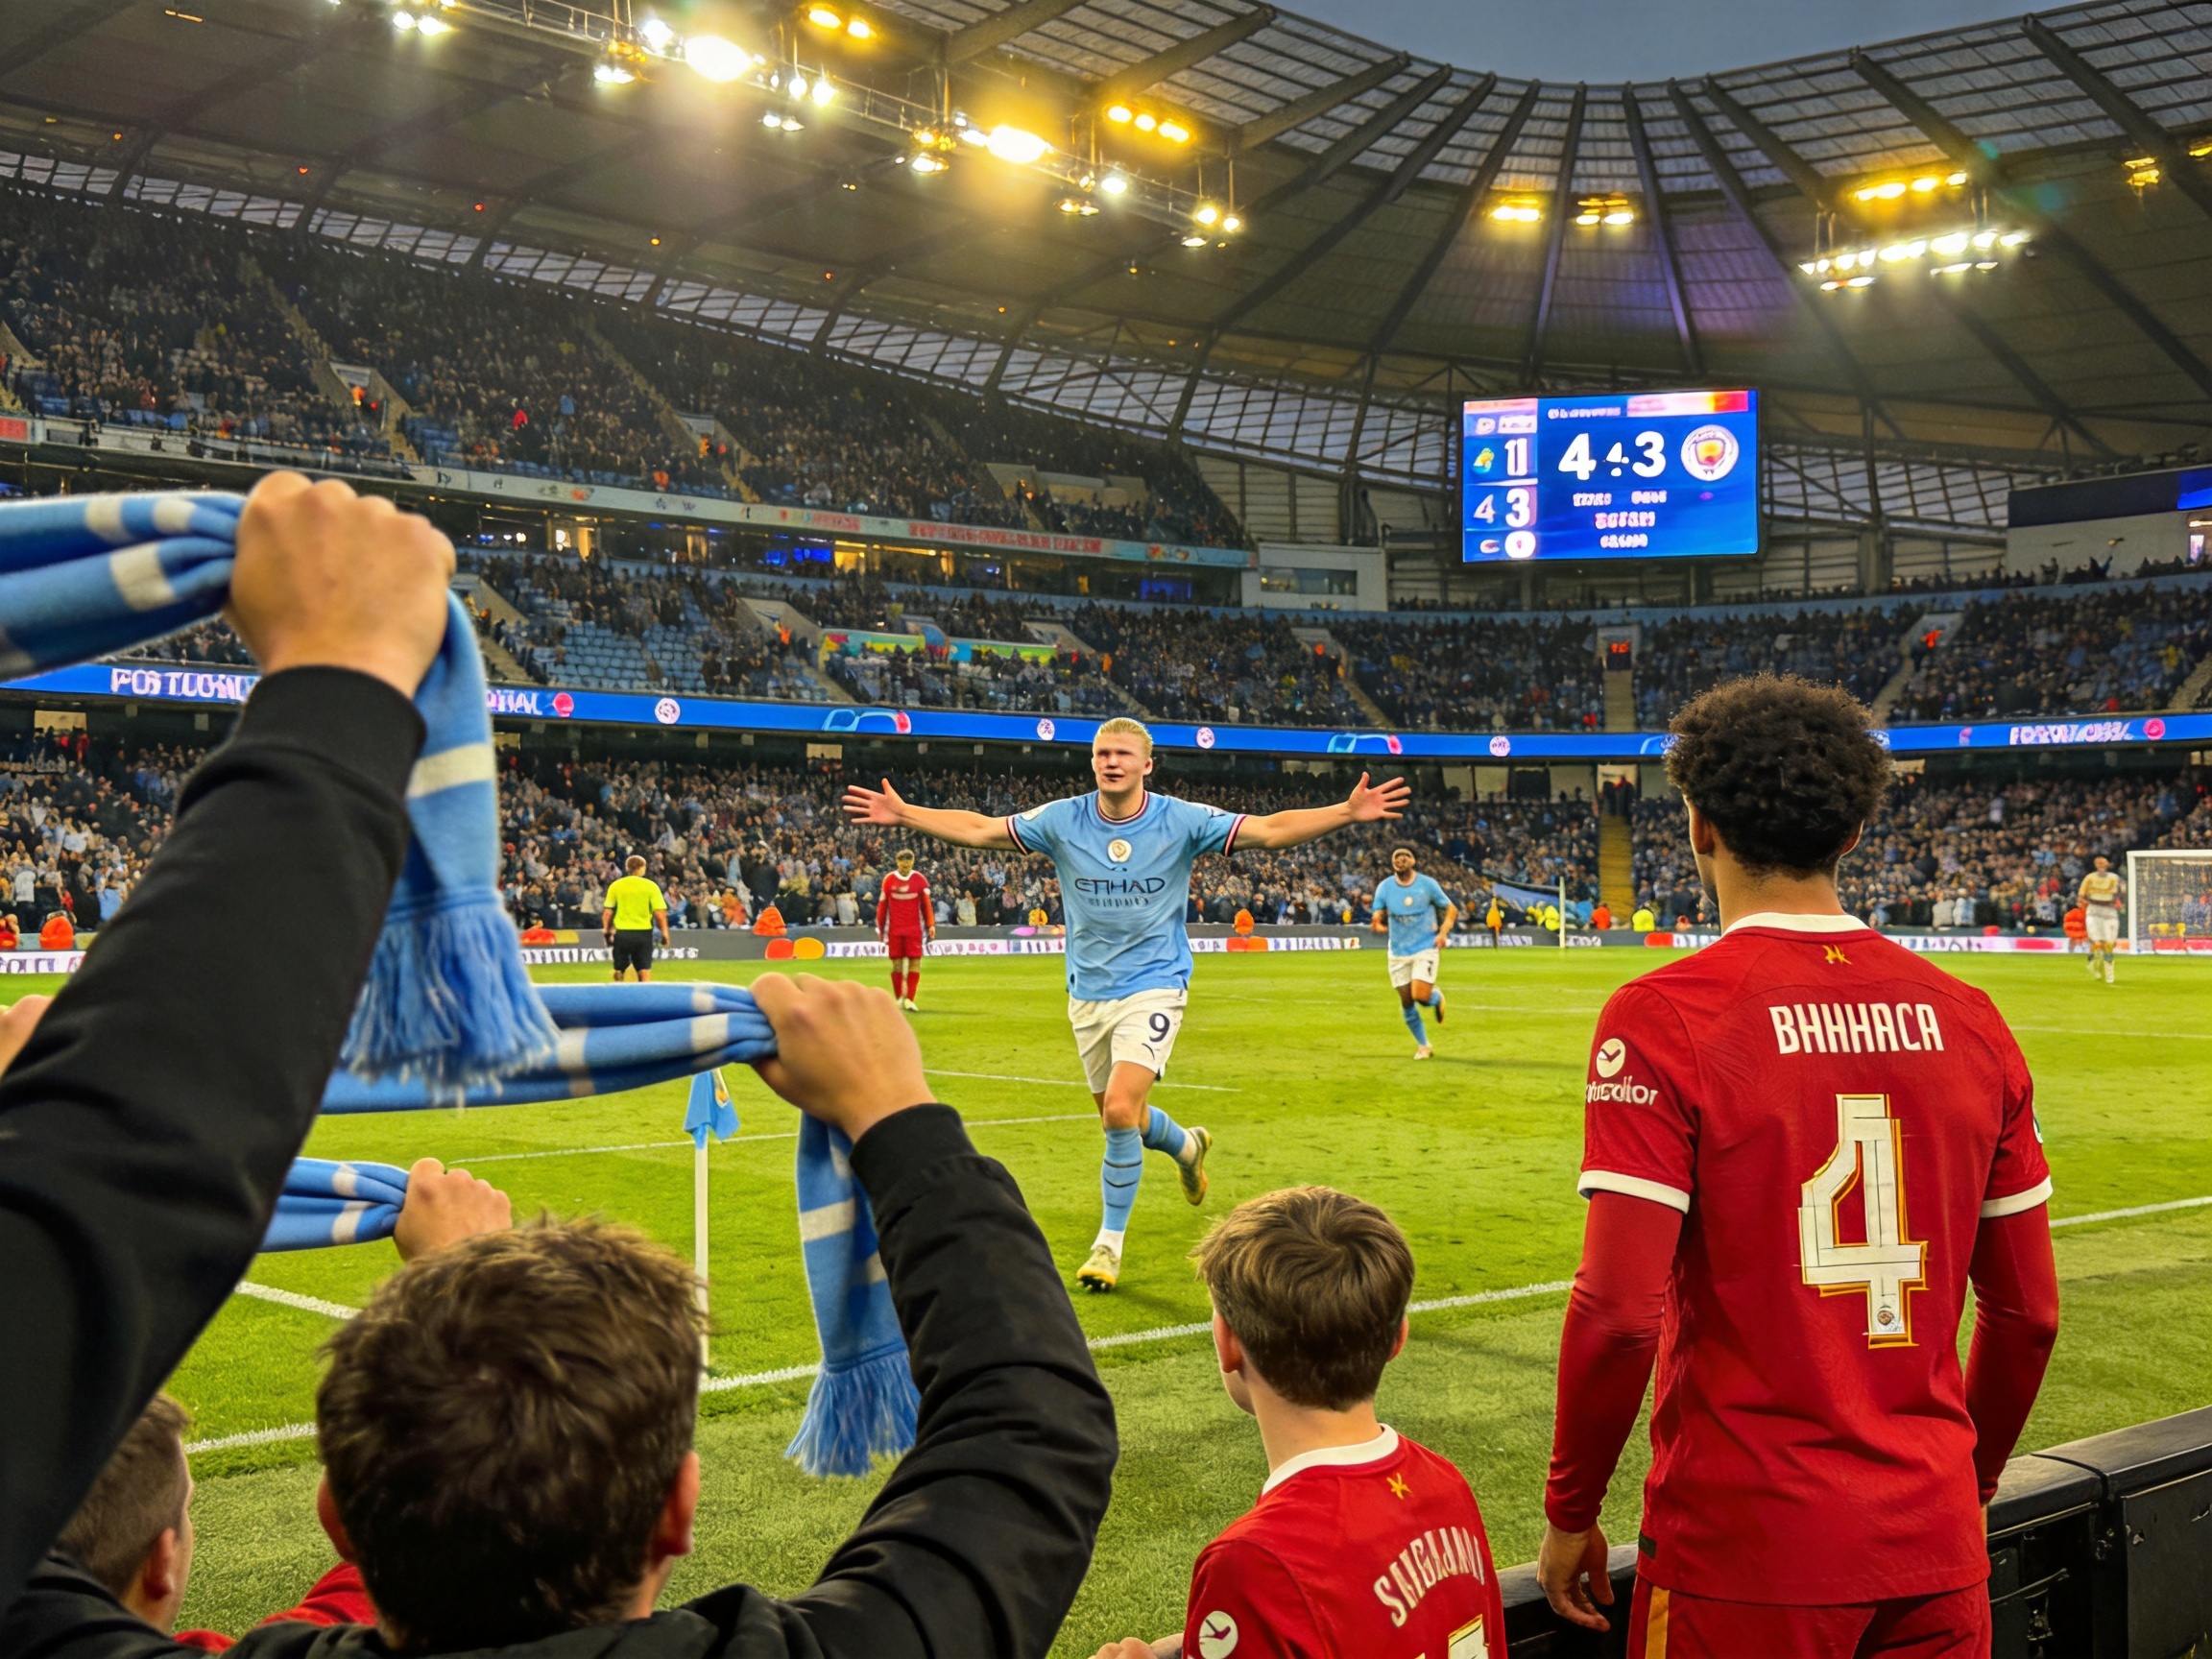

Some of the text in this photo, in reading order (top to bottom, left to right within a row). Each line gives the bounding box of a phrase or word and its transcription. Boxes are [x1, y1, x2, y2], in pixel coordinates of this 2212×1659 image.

[1631, 430, 1667, 478] 3
[1148, 1012, 1170, 1043] 9
[1768, 1002, 1945, 1055] BHHHACA
[1798, 1093, 1930, 1350] 4
